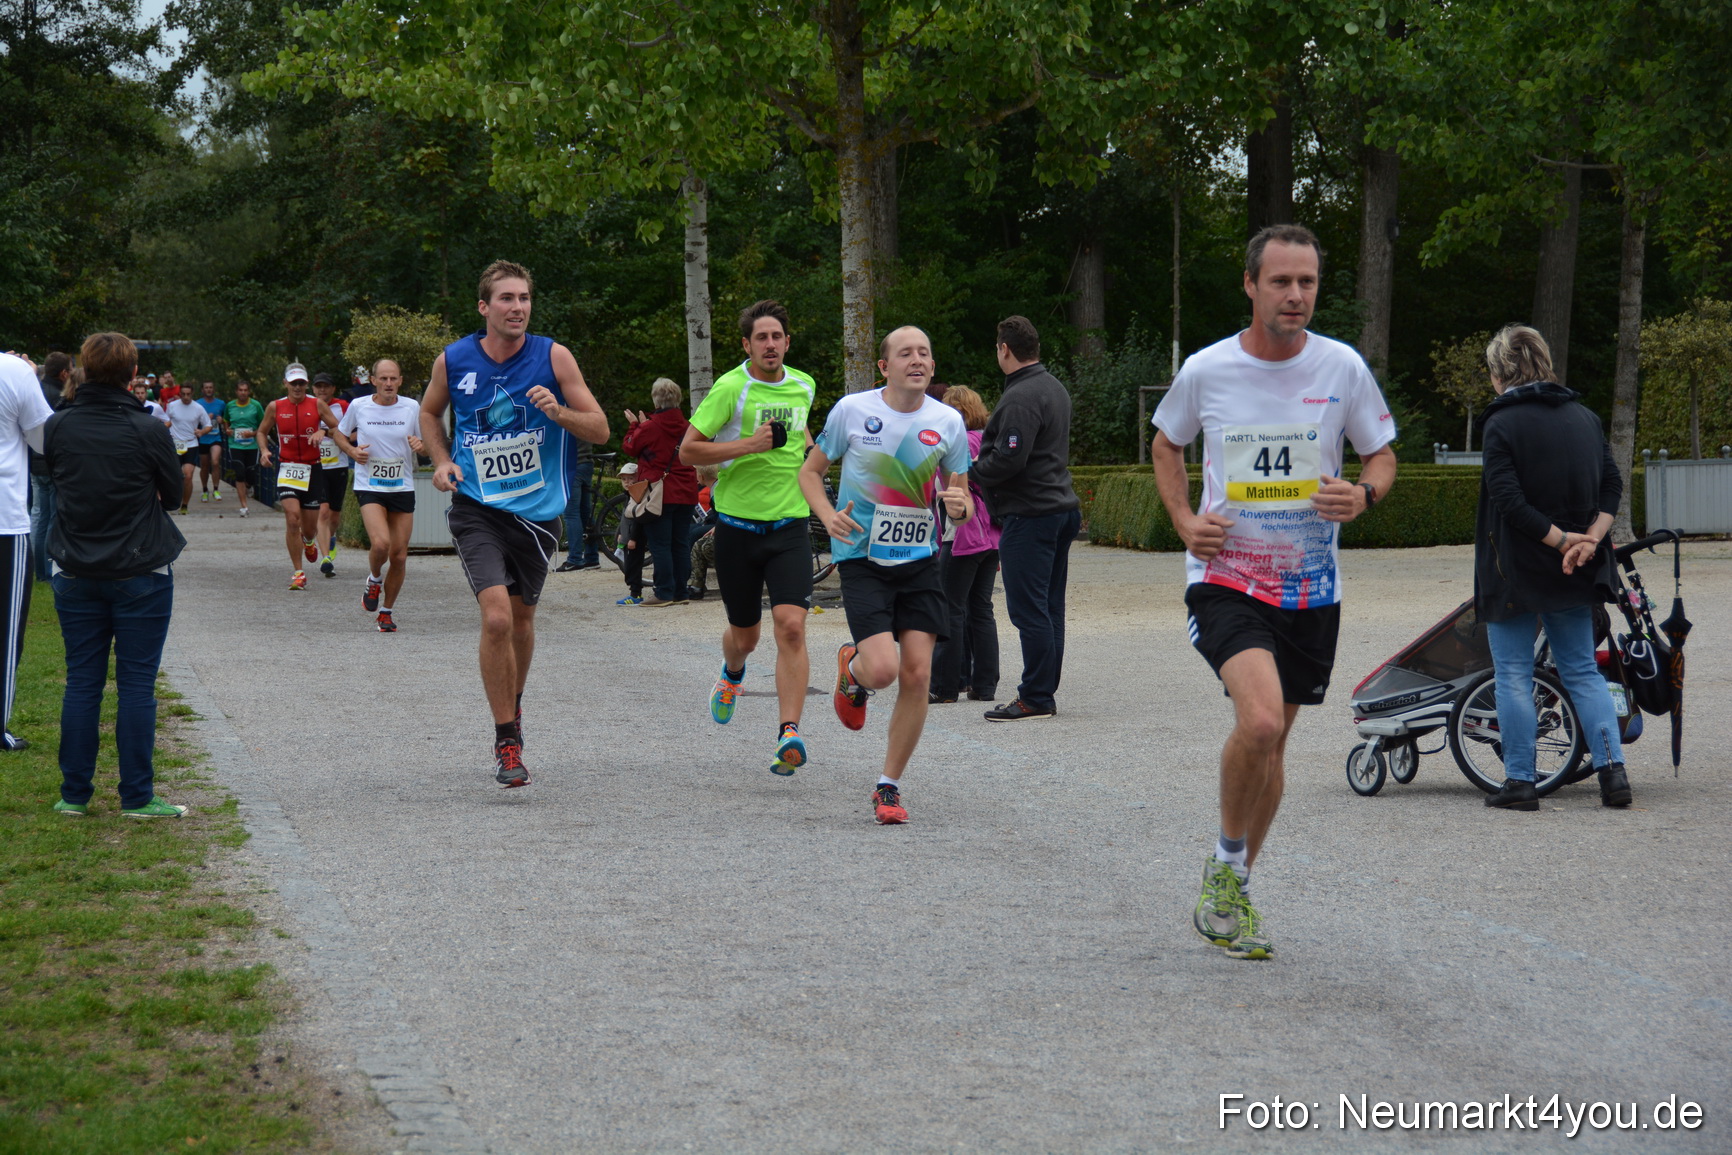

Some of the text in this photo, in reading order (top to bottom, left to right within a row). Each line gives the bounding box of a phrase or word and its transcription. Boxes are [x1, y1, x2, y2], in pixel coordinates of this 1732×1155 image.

[457, 372, 477, 394] 4
[1303, 396, 1340, 404] CeramTec
[762, 408, 792, 420] RUN
[1225, 433, 1304, 443] PARTL Neumarkt
[474, 441, 527, 456] PARTL Neumarkt
[482, 448, 536, 479] 2092
[1253, 446, 1292, 477] 44
[285, 469, 305, 480] 503
[373, 465, 401, 478] 2507
[500, 478, 528, 491] Martin
[1246, 486, 1300, 499] Matthias
[876, 510, 927, 520] PARTL Neumarkt
[877, 520, 929, 543] 2696
[889, 548, 912, 558] David
[1371, 695, 1416, 709] chariot
